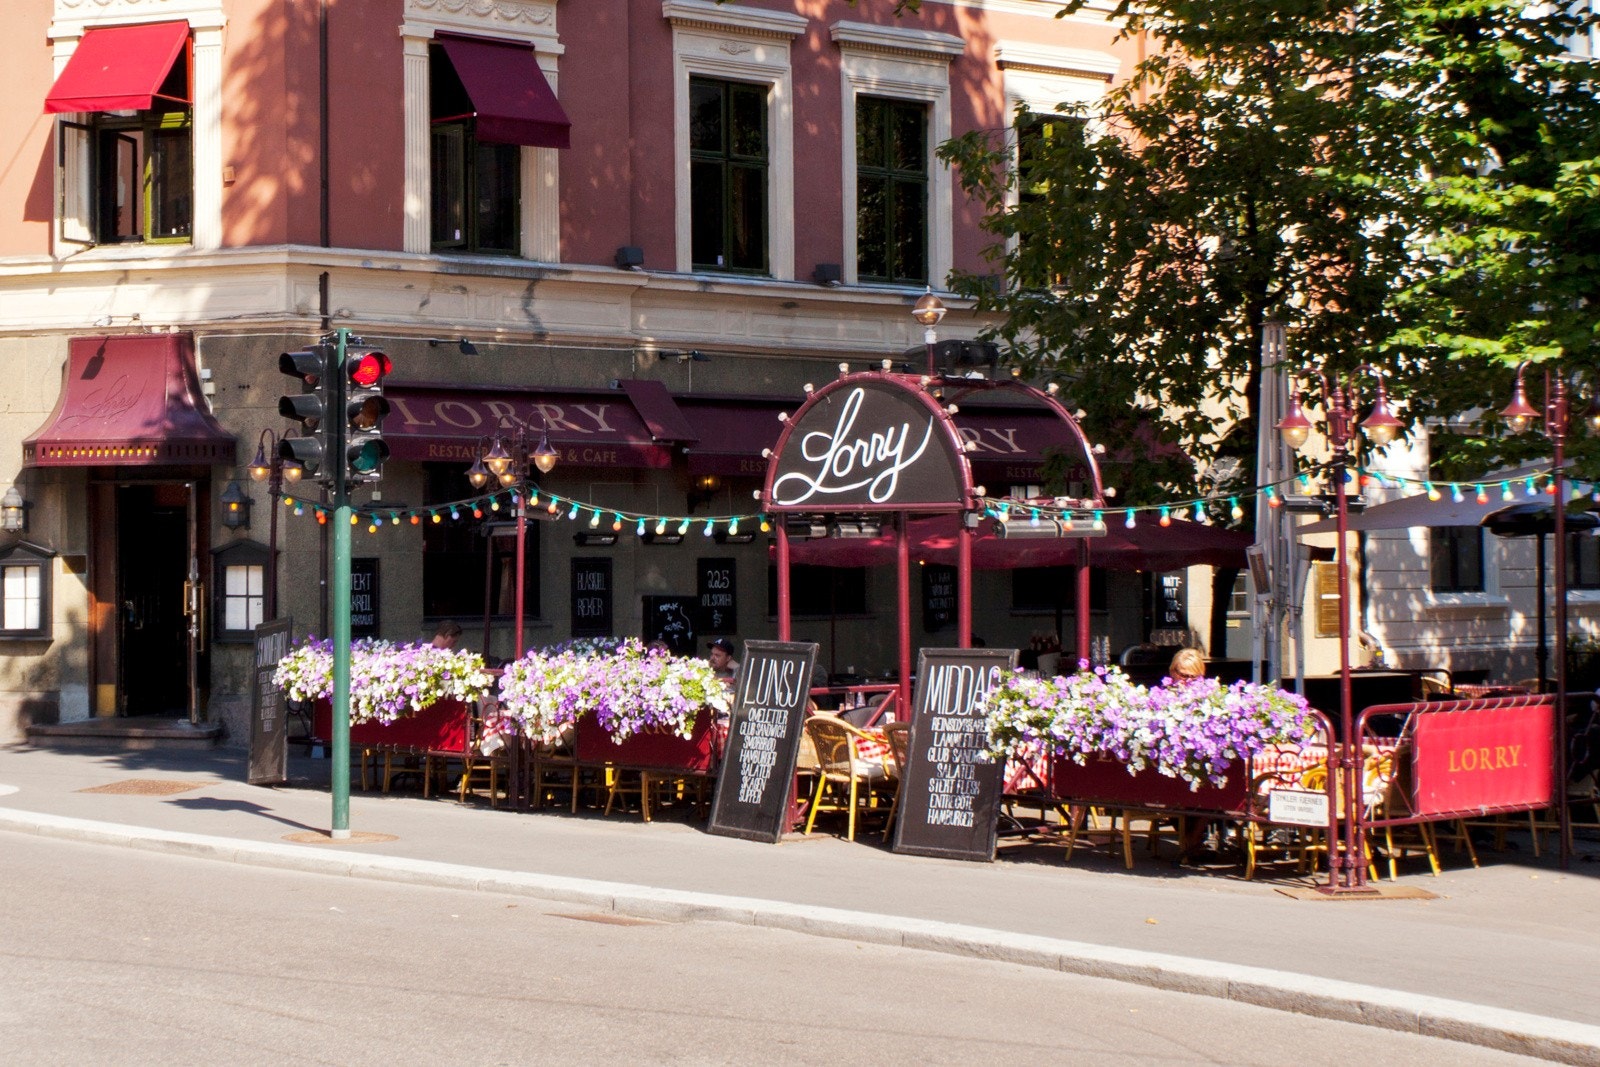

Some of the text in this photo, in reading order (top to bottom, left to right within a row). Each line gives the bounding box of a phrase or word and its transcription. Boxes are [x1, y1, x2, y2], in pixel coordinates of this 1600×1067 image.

[388, 397, 617, 433] LORRY
[772, 387, 934, 506] Lorry
[707, 570, 730, 589] 225
[743, 658, 806, 708] LUNSJ
[748, 707, 789, 725] OMELETTER
[739, 721, 787, 738] CLUB SANDWICH
[739, 748, 777, 766] HAMBURGER
[927, 747, 950, 764] CLUB
[1448, 744, 1522, 772] LORRY
[741, 763, 771, 779] SALATER
[937, 763, 975, 780] SALATER
[927, 808, 974, 828] HAMBURGER
